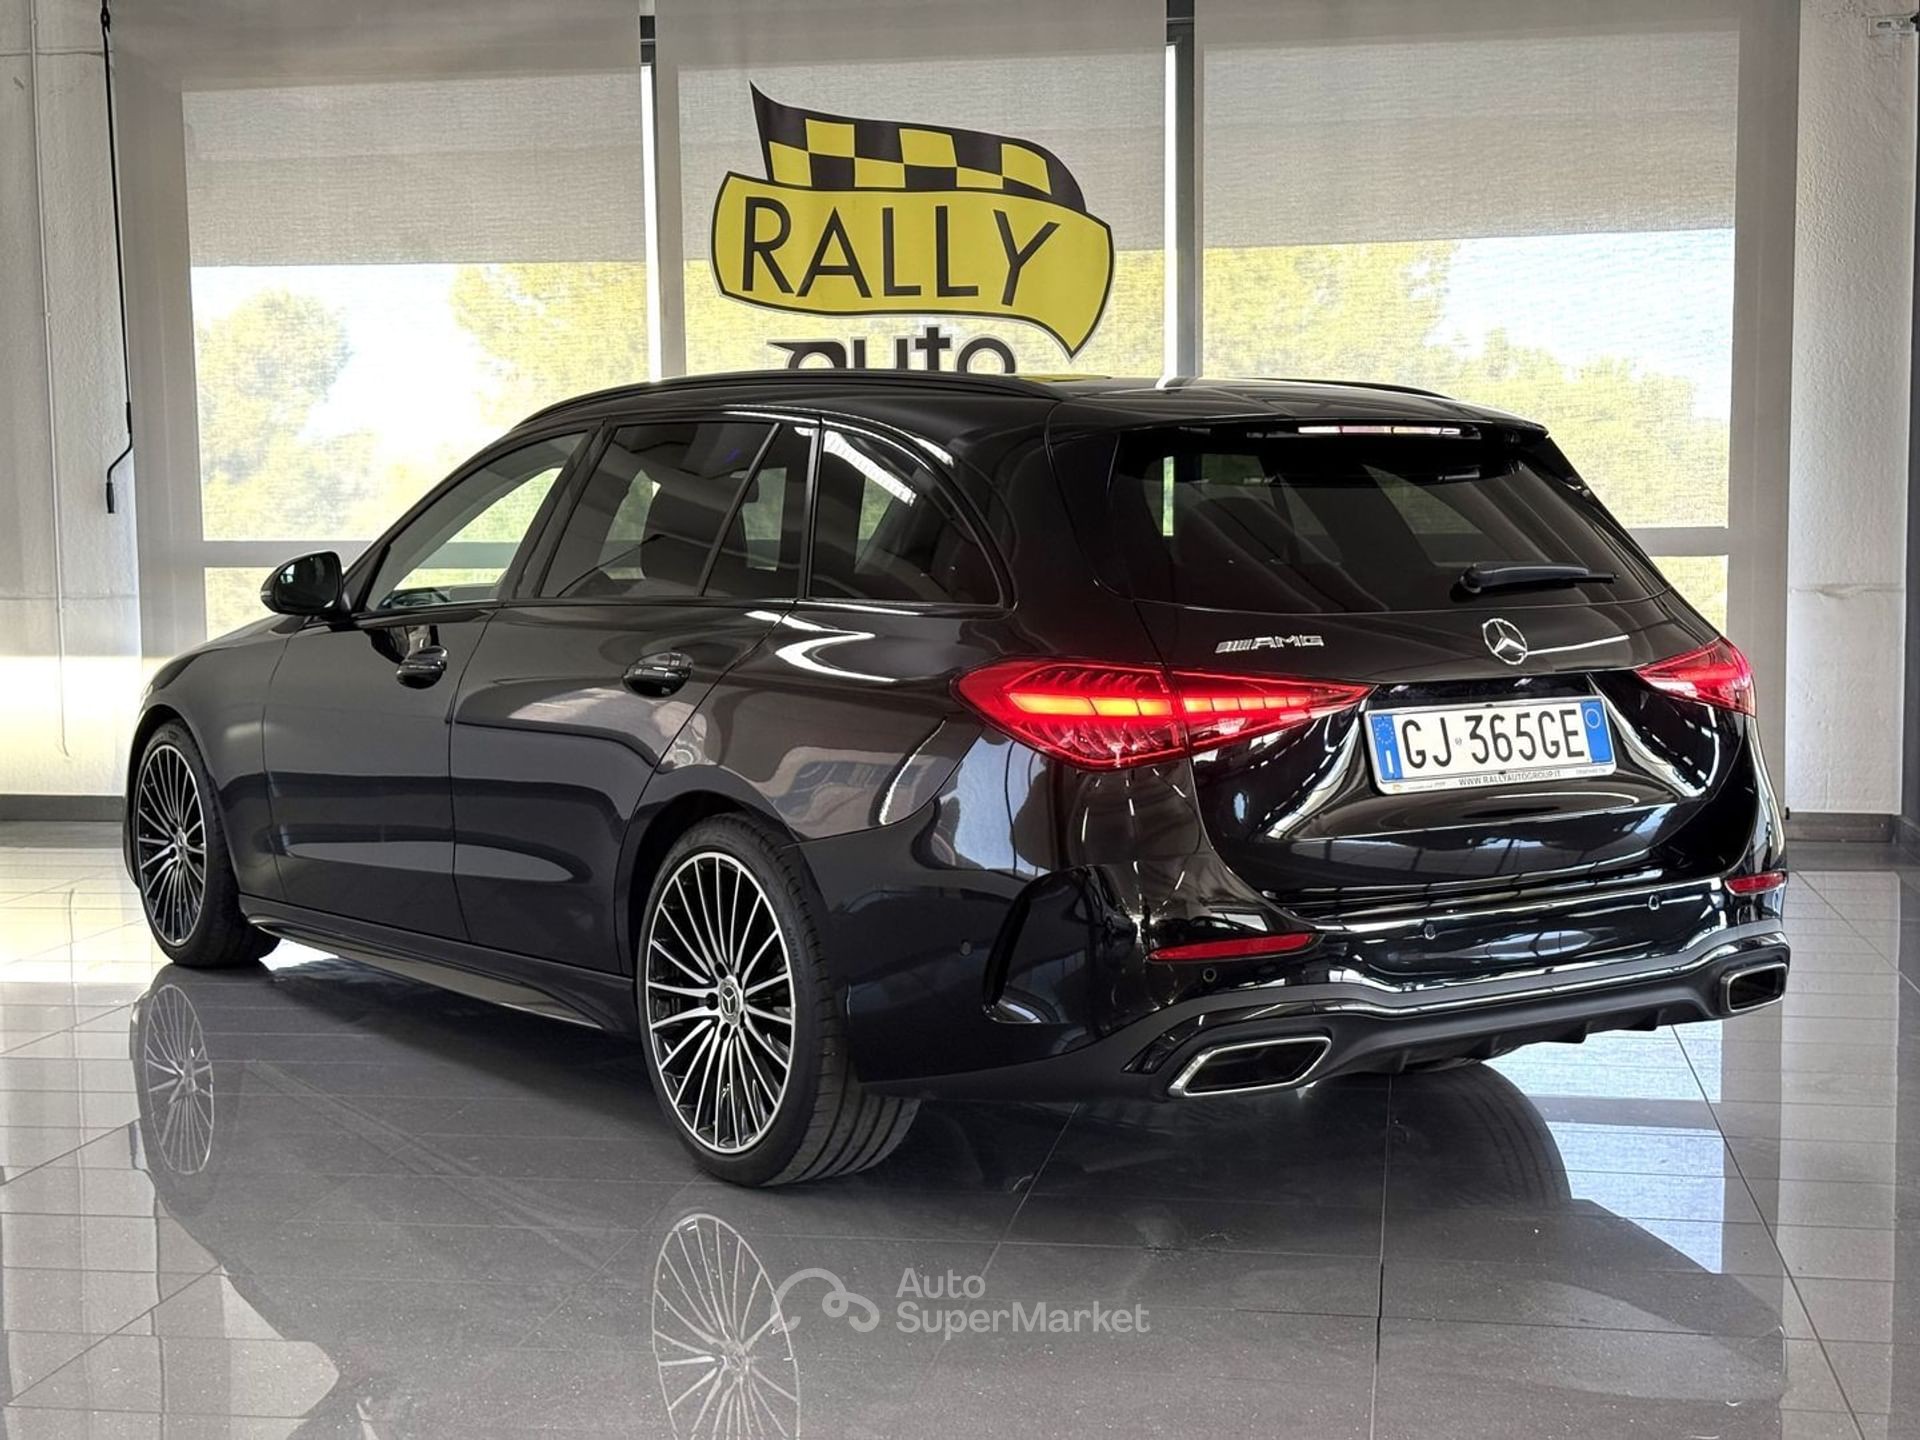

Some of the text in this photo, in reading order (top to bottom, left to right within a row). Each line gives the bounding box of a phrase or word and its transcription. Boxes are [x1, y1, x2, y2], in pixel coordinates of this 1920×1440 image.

[742, 196, 1060, 306] RALLY
[1402, 717, 1452, 769] GJ
[1465, 709, 1585, 764] 365GE
